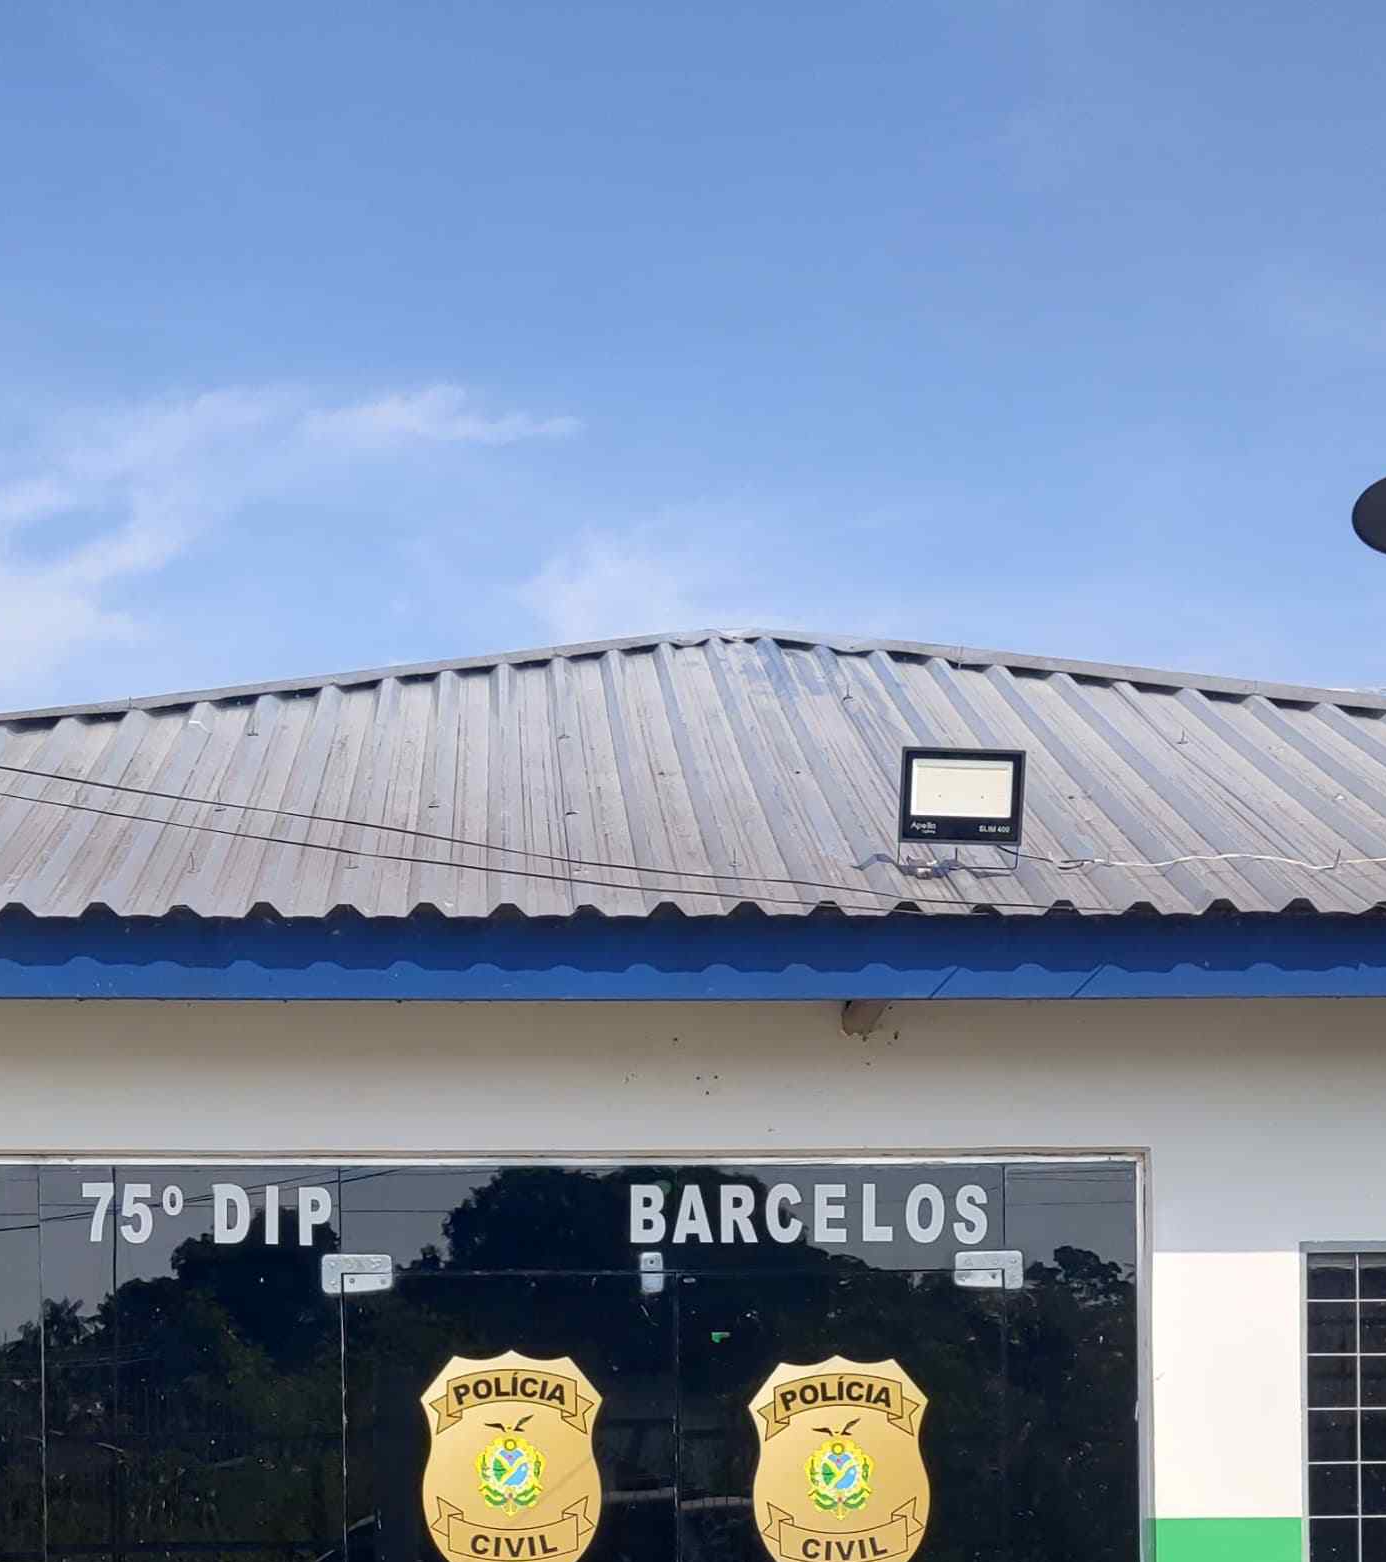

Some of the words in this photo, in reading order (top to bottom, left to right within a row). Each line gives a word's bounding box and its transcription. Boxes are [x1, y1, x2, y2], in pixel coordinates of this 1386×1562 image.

[212, 1183, 332, 1246] DIP
[630, 1183, 988, 1245] BARCELOS
[452, 1372, 566, 1406] POLÍCIA
[779, 1376, 892, 1413] POLÍCIA
[470, 1533, 559, 1558] CIVIL
[801, 1536, 888, 1561] CIVIL
